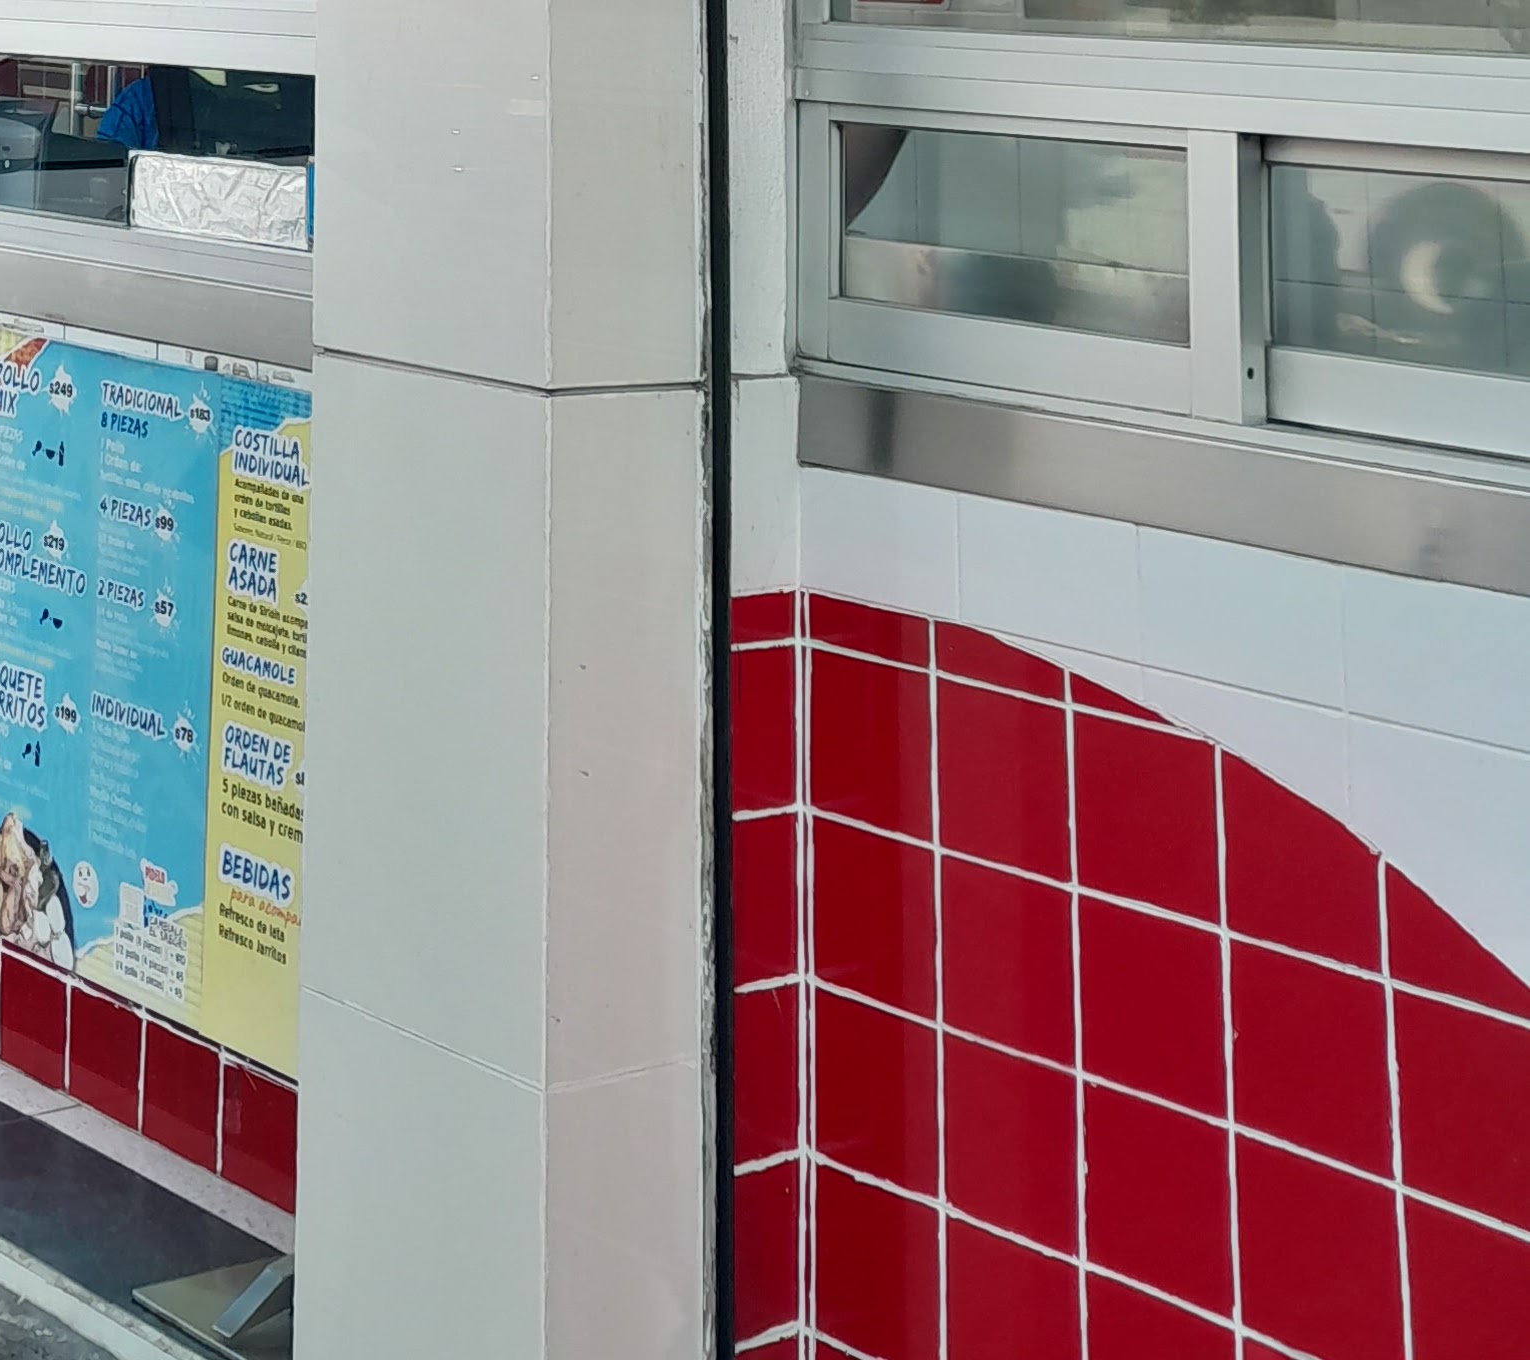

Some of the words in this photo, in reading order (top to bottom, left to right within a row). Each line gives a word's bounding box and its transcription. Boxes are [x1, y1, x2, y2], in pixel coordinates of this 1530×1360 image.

[49, 381, 73, 398] $249
[102, 382, 182, 419] TRADICIONAL
[100, 411, 107, 428] 8
[111, 412, 149, 439] PIEZAS
[235, 429, 300, 465] COSTILLA
[234, 451, 311, 488] INDIVIDUAL
[100, 497, 107, 514] 4
[111, 499, 151, 528] PIEZAS
[155, 515, 174, 532] $99
[229, 542, 278, 574] CARNE
[97, 579, 105, 597] 2
[107, 581, 145, 609] PIEZAS
[154, 599, 175, 618] $57
[228, 566, 277, 603] ASADA
[221, 646, 296, 685] GUACAMOLE
[54, 704, 78, 724] $199
[91, 693, 166, 738] INDIVIDUAL
[174, 726, 194, 744] $78
[225, 725, 270, 757] ORDEN
[273, 741, 291, 764] DE
[224, 747, 285, 787] FLAUTAS
[222, 778, 229, 794] 5
[231, 783, 262, 806] piezas
[221, 801, 239, 820] con
[242, 809, 267, 830] salsa
[222, 850, 291, 901] BEBIDAS
[219, 902, 254, 929] Refresco
[219, 923, 253, 951] Refresco
